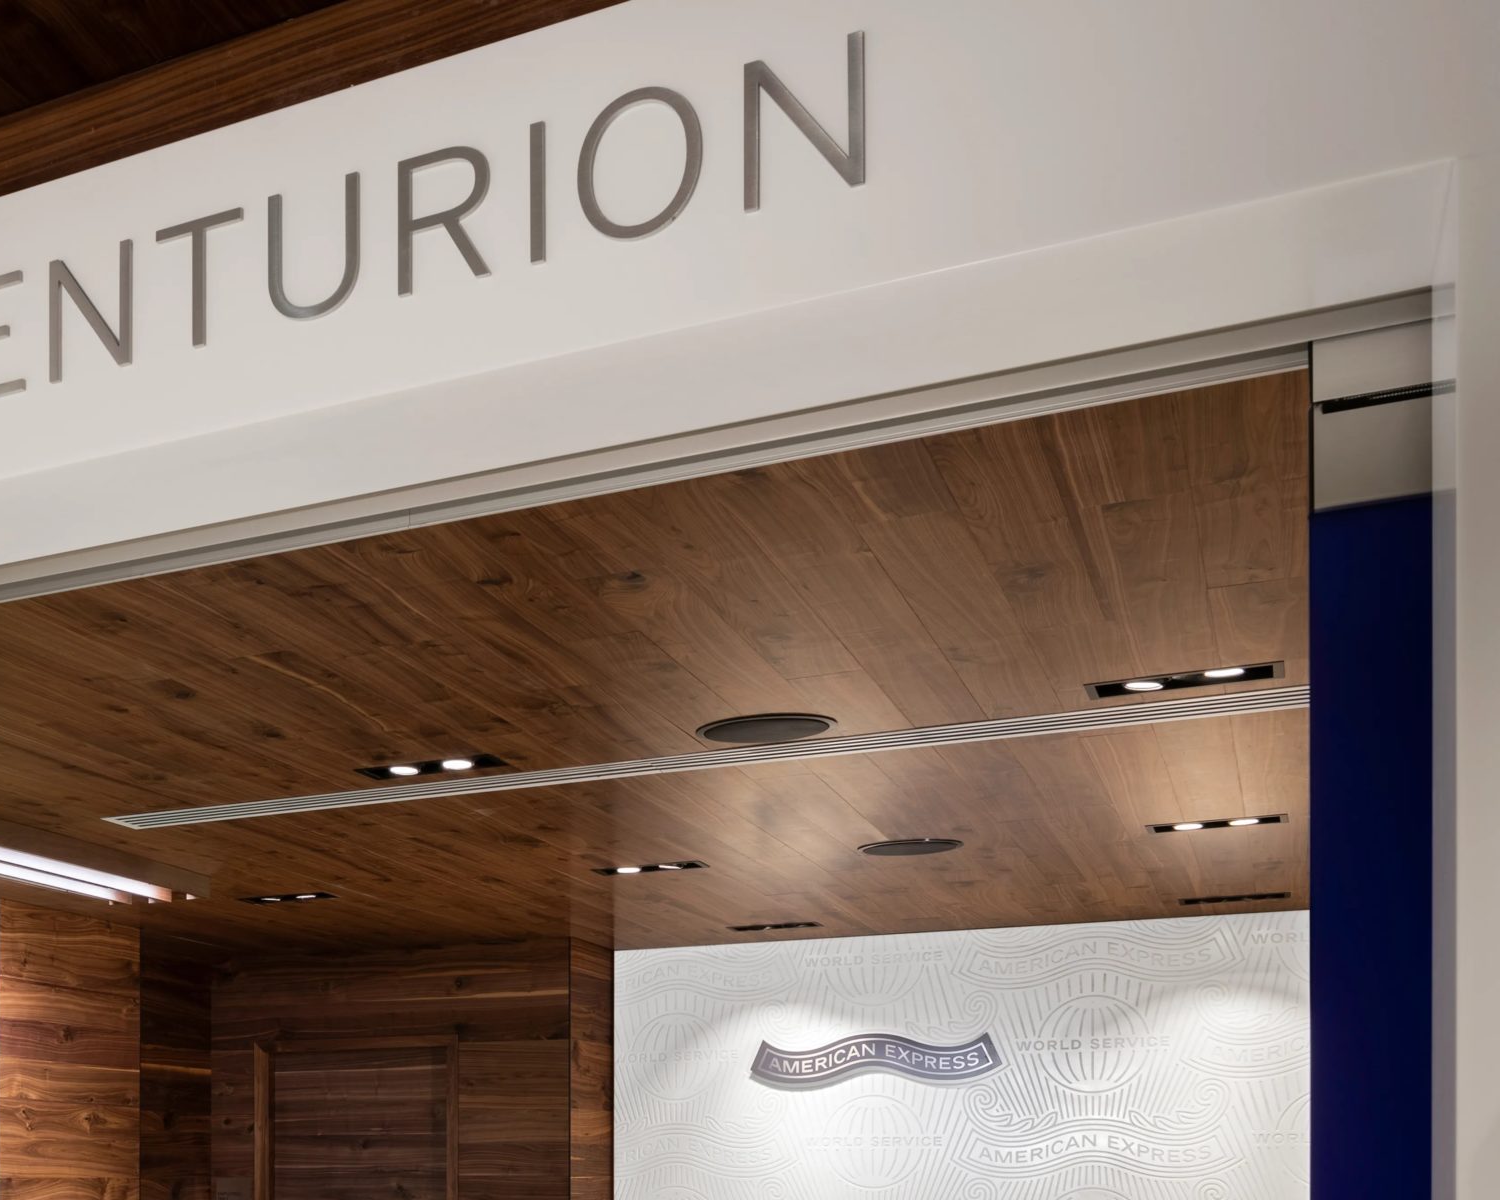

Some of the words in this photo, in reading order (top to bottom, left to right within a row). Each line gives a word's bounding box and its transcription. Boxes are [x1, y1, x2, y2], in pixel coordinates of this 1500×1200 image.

[804, 955, 864, 968] WORLD
[871, 950, 944, 965] SERVICE
[977, 941, 1097, 976] AMERICAN
[1107, 941, 1212, 967] EXPRESS
[688, 964, 772, 988] EXPRESS
[1015, 1039, 1082, 1052] WORLD
[1090, 1035, 1171, 1050] SERVICE
[674, 1050, 739, 1062] SERVICE
[769, 1043, 876, 1074] AMERICAN
[885, 1045, 980, 1072] EXPRESS
[805, 1136, 862, 1148] WORLD
[870, 1135, 943, 1147] SERVICE
[979, 1134, 1097, 1164] AMERICAN
[1107, 1135, 1211, 1163] EXPRESS
